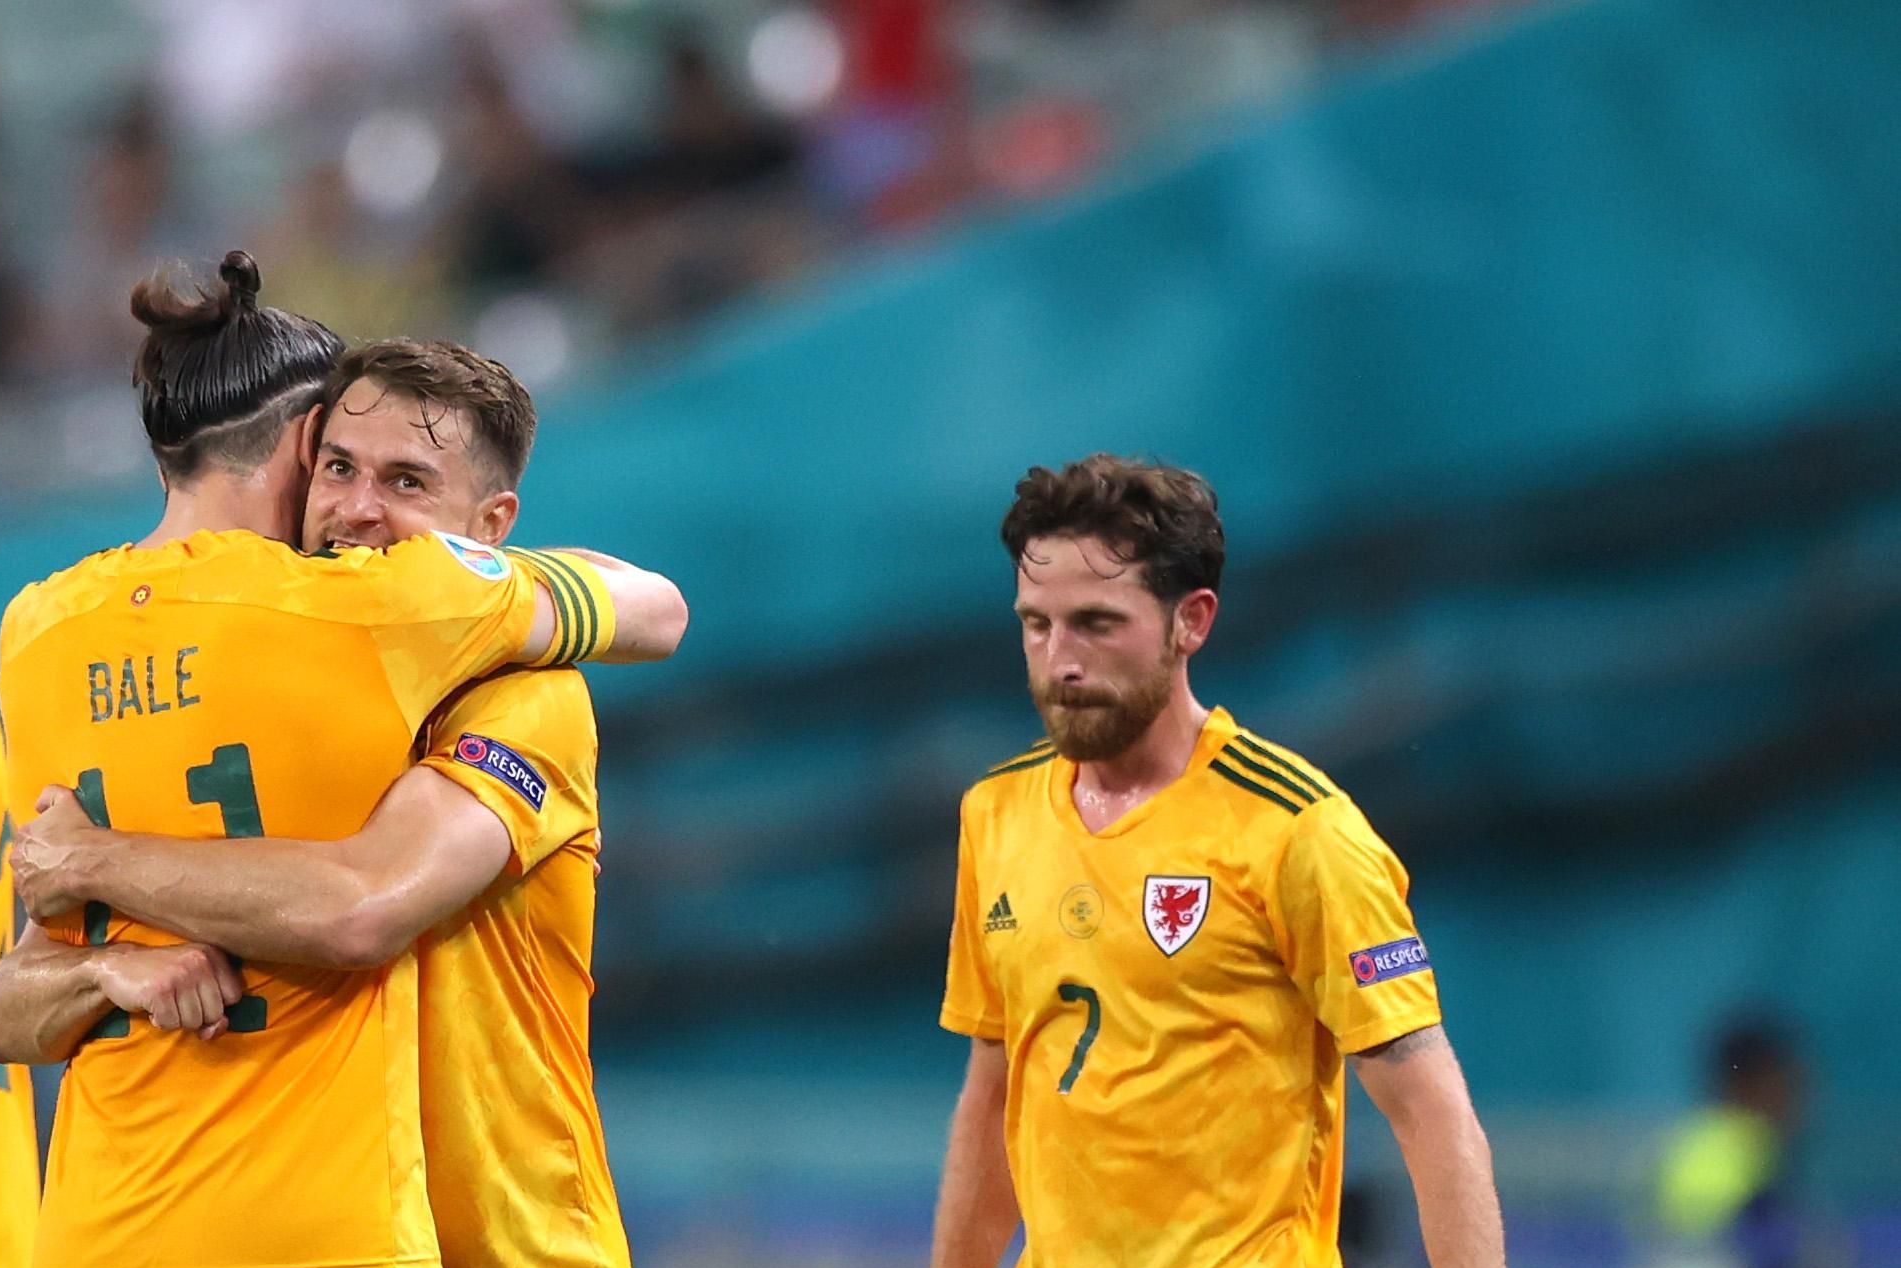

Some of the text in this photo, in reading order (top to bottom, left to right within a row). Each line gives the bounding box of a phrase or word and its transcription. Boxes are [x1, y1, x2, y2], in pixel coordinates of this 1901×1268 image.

[88, 646, 201, 723] BALE
[487, 750, 544, 802] RESPECT
[1374, 945, 1428, 972] RESPECT
[1057, 983, 1101, 1095] 7
